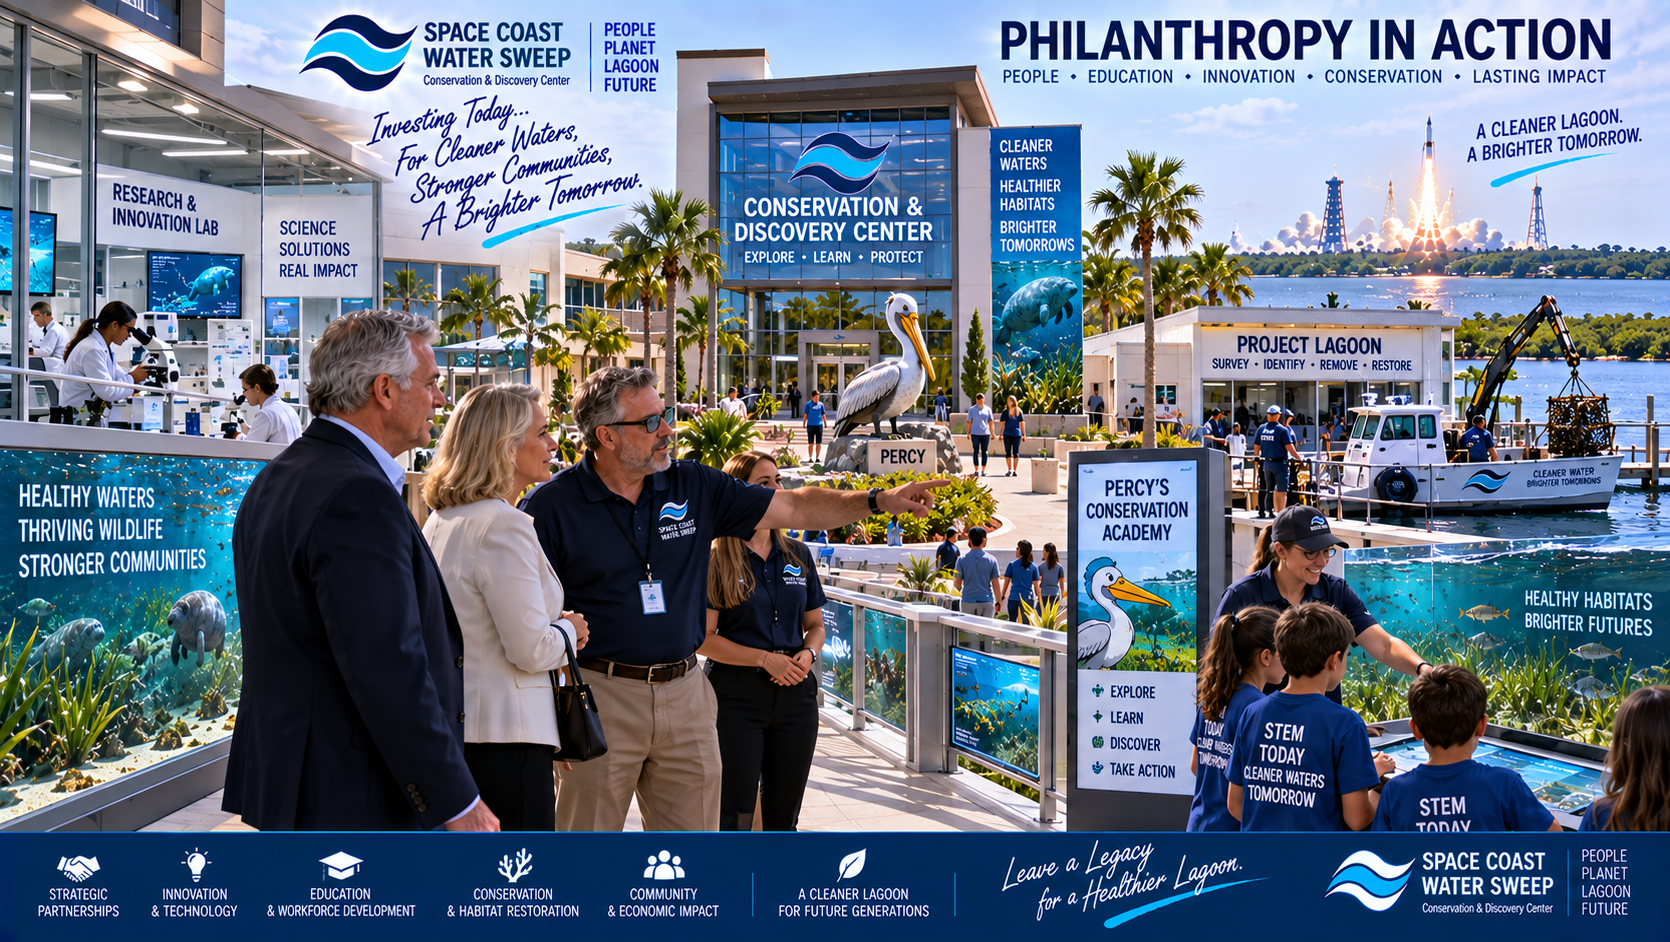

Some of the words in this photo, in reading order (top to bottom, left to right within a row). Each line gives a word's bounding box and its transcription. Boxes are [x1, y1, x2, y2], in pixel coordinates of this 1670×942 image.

[1000, 138, 1053, 153] CLEANER
[1000, 157, 1048, 171] WATERS
[1000, 179, 1061, 193] HEALTHIER
[113, 182, 183, 210] RESEARCH
[187, 195, 197, 212] &
[1000, 197, 1055, 211] HABITATS
[744, 196, 899, 217] CONSERVATION
[906, 196, 923, 217] &
[112, 207, 191, 234] INNOVATION
[195, 218, 219, 236] LAB
[279, 220, 337, 236] SCIENCE
[1000, 219, 1057, 234] BRIGHTER
[734, 221, 847, 242] DISCOVERY
[853, 221, 933, 242] CENTER
[279, 242, 350, 257] SOLUTIONS
[1000, 237, 1075, 252] TOMORROWS
[744, 250, 795, 264] EXPLORE
[813, 250, 851, 264] LEARN
[870, 250, 924, 264] PROTECT
[279, 263, 309, 278] REAL
[313, 263, 358, 278] IMPACT
[1237, 335, 1310, 355] PROJECT
[1315, 336, 1382, 355] LAGOON
[1212, 358, 1249, 371] SURVEY
[1263, 358, 1305, 371] IDENTIFY
[1320, 359, 1358, 371] REMOVE
[1372, 359, 1412, 372] RESTORE
[880, 448, 926, 465] PERCY
[1533, 468, 1567, 478] CLEANER
[1569, 467, 1595, 477] WATER
[1105, 478, 1170, 497] PERCY'S
[19, 484, 91, 508] HEALTHY
[96, 486, 155, 509] WATERS
[1086, 502, 1188, 519] CONSERVATION
[18, 518, 94, 542] THRIVING
[98, 518, 163, 541] WILDLIFE
[1102, 524, 1172, 541] ACADEMY
[18, 552, 105, 579] STRONGER
[110, 548, 207, 574] COMMUNITIES
[1524, 589, 1580, 608] HEALTHY
[1584, 591, 1653, 612] HABITATS
[1524, 613, 1584, 632] BRIGHTER
[1588, 614, 1653, 637] FUTURES
[1110, 685, 1156, 699] EXPLORE
[1110, 711, 1144, 725] LEARN
[1263, 721, 1305, 742] STEM
[1110, 736, 1161, 752] DISCOVER
[1259, 743, 1306, 766] TODAY
[1110, 762, 1135, 776] TAKE
[1138, 764, 1176, 779] ACTION
[1243, 764, 1284, 784] CLEANER
[1285, 769, 1325, 790] WATERS
[1247, 784, 1316, 808] TOMORROW
[1419, 796, 1466, 817] STEM
